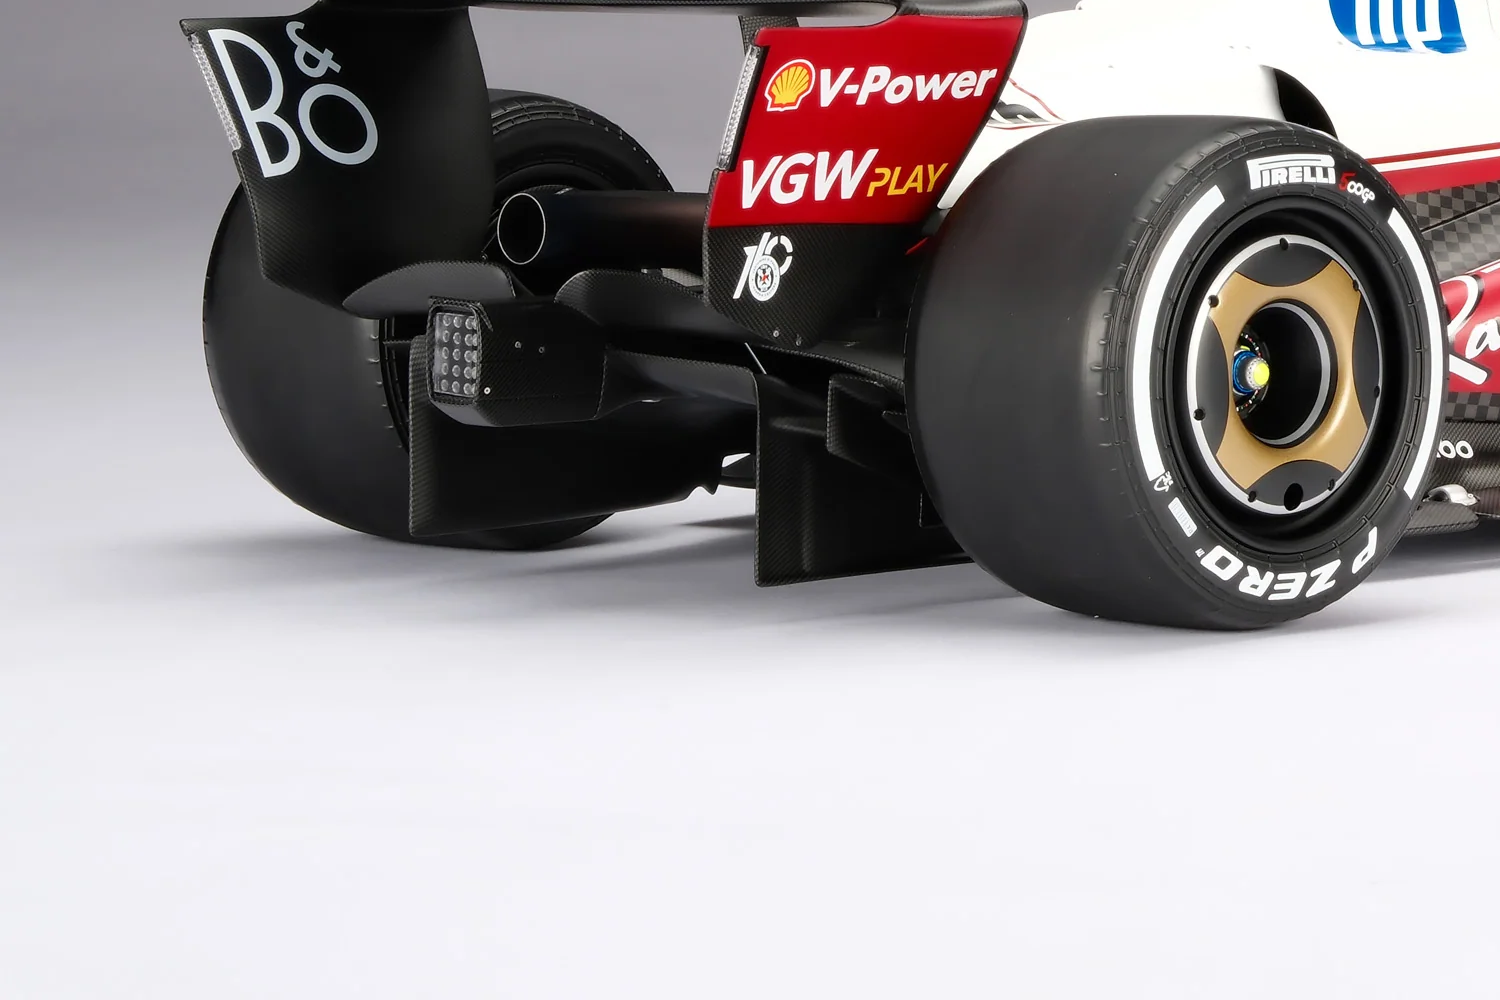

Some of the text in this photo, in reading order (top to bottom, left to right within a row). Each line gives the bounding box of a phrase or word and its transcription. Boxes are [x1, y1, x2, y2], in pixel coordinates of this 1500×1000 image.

[819, 66, 998, 107] V-Power
[741, 149, 949, 209] VGW PLAY
[1246, 153, 1336, 190] PIRELLI
[1200, 545, 1341, 601] ZERO
[1352, 526, 1377, 574] P
